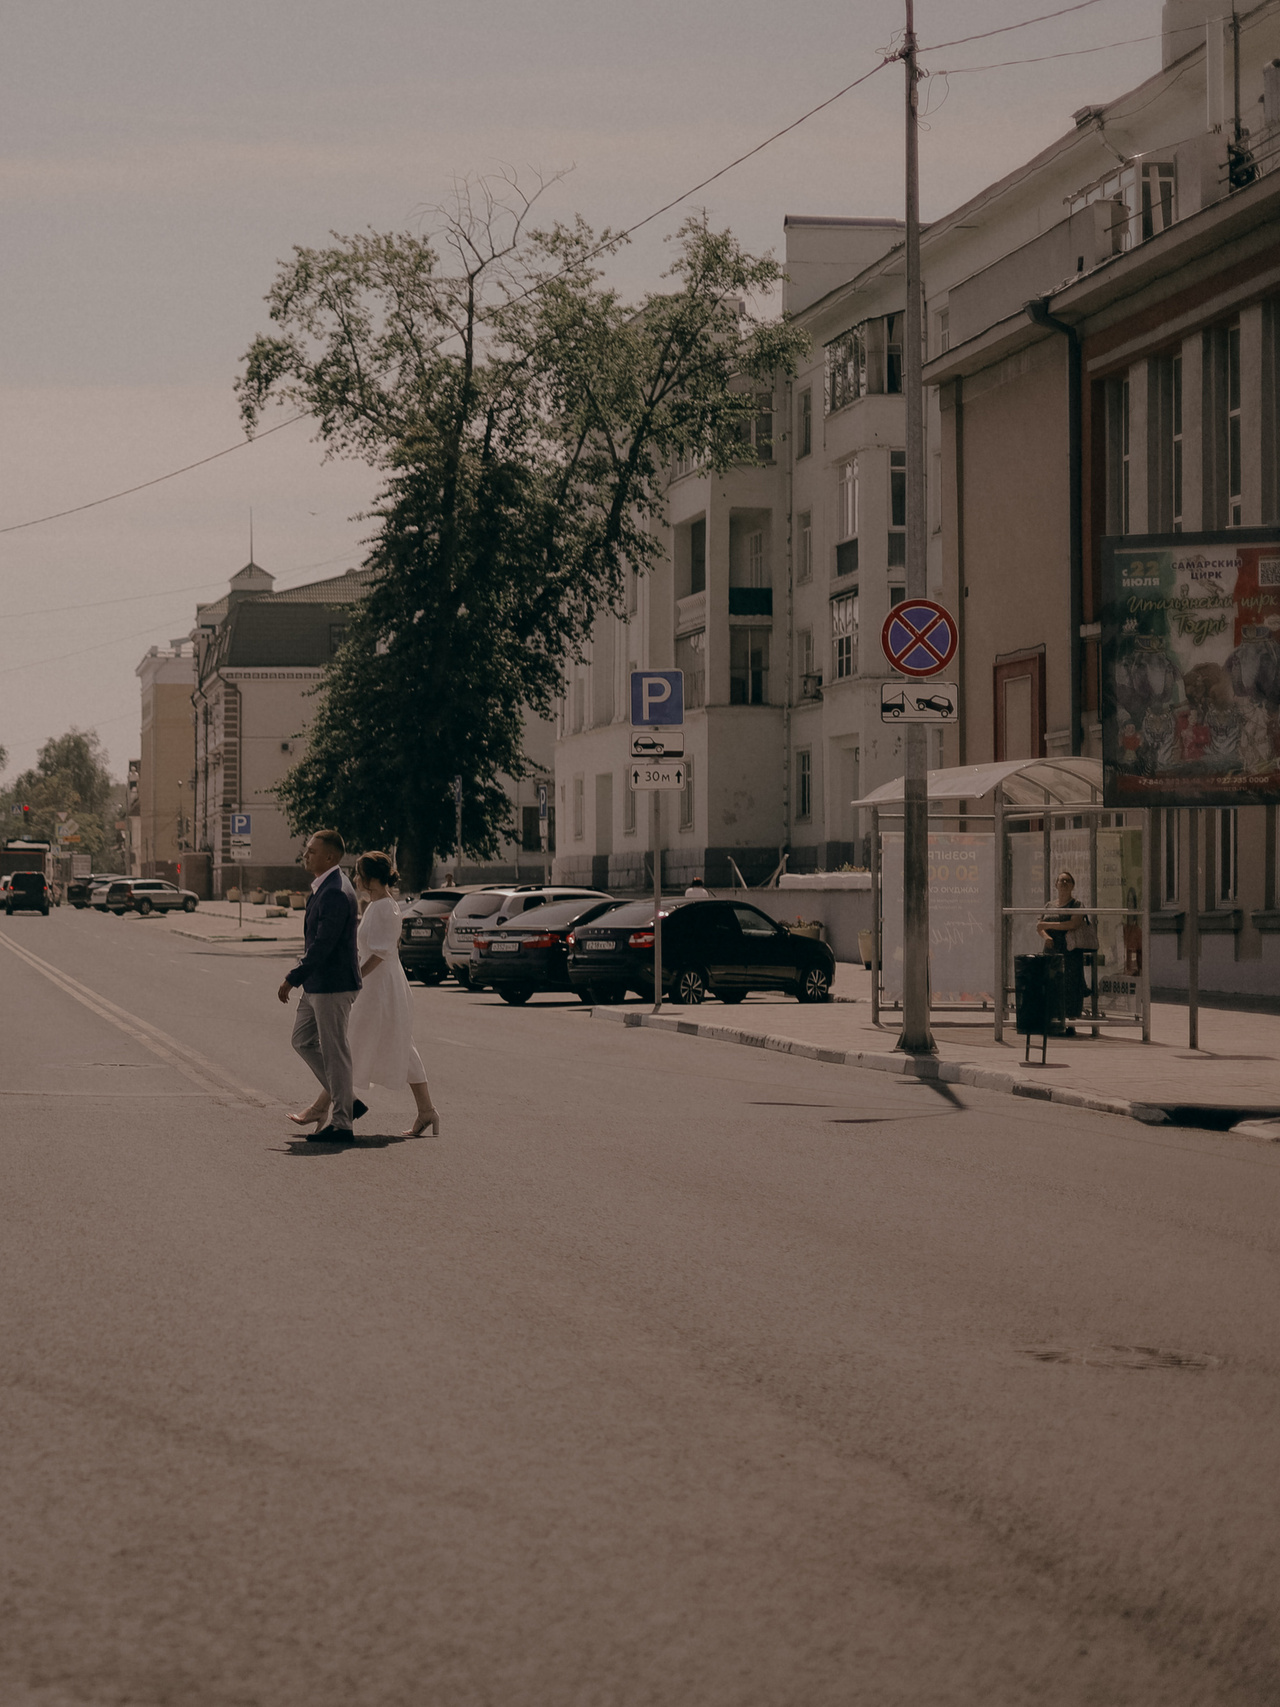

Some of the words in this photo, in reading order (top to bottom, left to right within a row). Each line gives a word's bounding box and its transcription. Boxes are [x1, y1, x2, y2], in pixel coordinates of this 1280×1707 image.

[1130, 560, 1160, 577] 22
[1171, 557, 1242, 570] САМАРСКИЙ
[1122, 577, 1160, 587] ИЮЛЯ
[1191, 571, 1222, 580] ЦИРК
[642, 677, 672, 720] P
[235, 816, 247, 833] P
